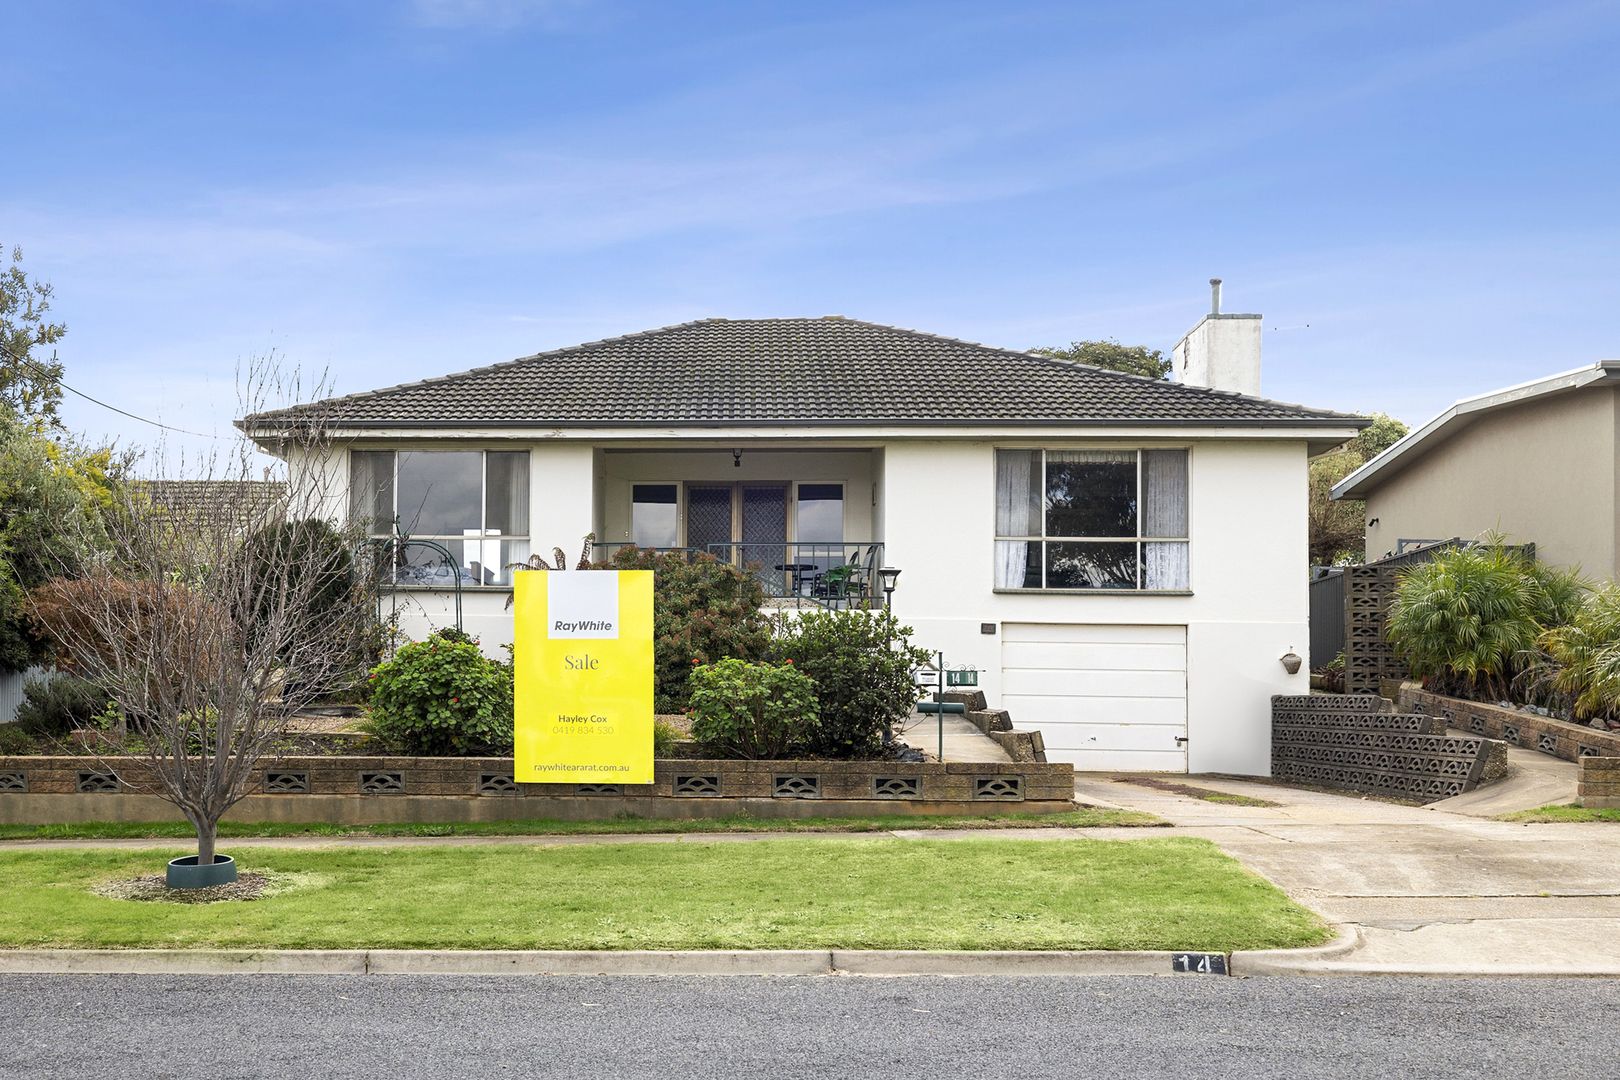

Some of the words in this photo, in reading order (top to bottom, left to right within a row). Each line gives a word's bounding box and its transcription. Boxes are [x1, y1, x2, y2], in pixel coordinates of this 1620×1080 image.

[554, 621, 612, 632] RayWhite
[564, 654, 599, 670] Sale
[951, 673, 960, 684] 14
[558, 714, 589, 724] Hayley
[590, 714, 608, 723] Cox
[552, 726, 576, 735] 0419
[577, 726, 595, 735] 834
[598, 726, 615, 735] 530
[533, 762, 630, 772] raywhiteararat.com.au
[1179, 955, 1212, 973] 14
